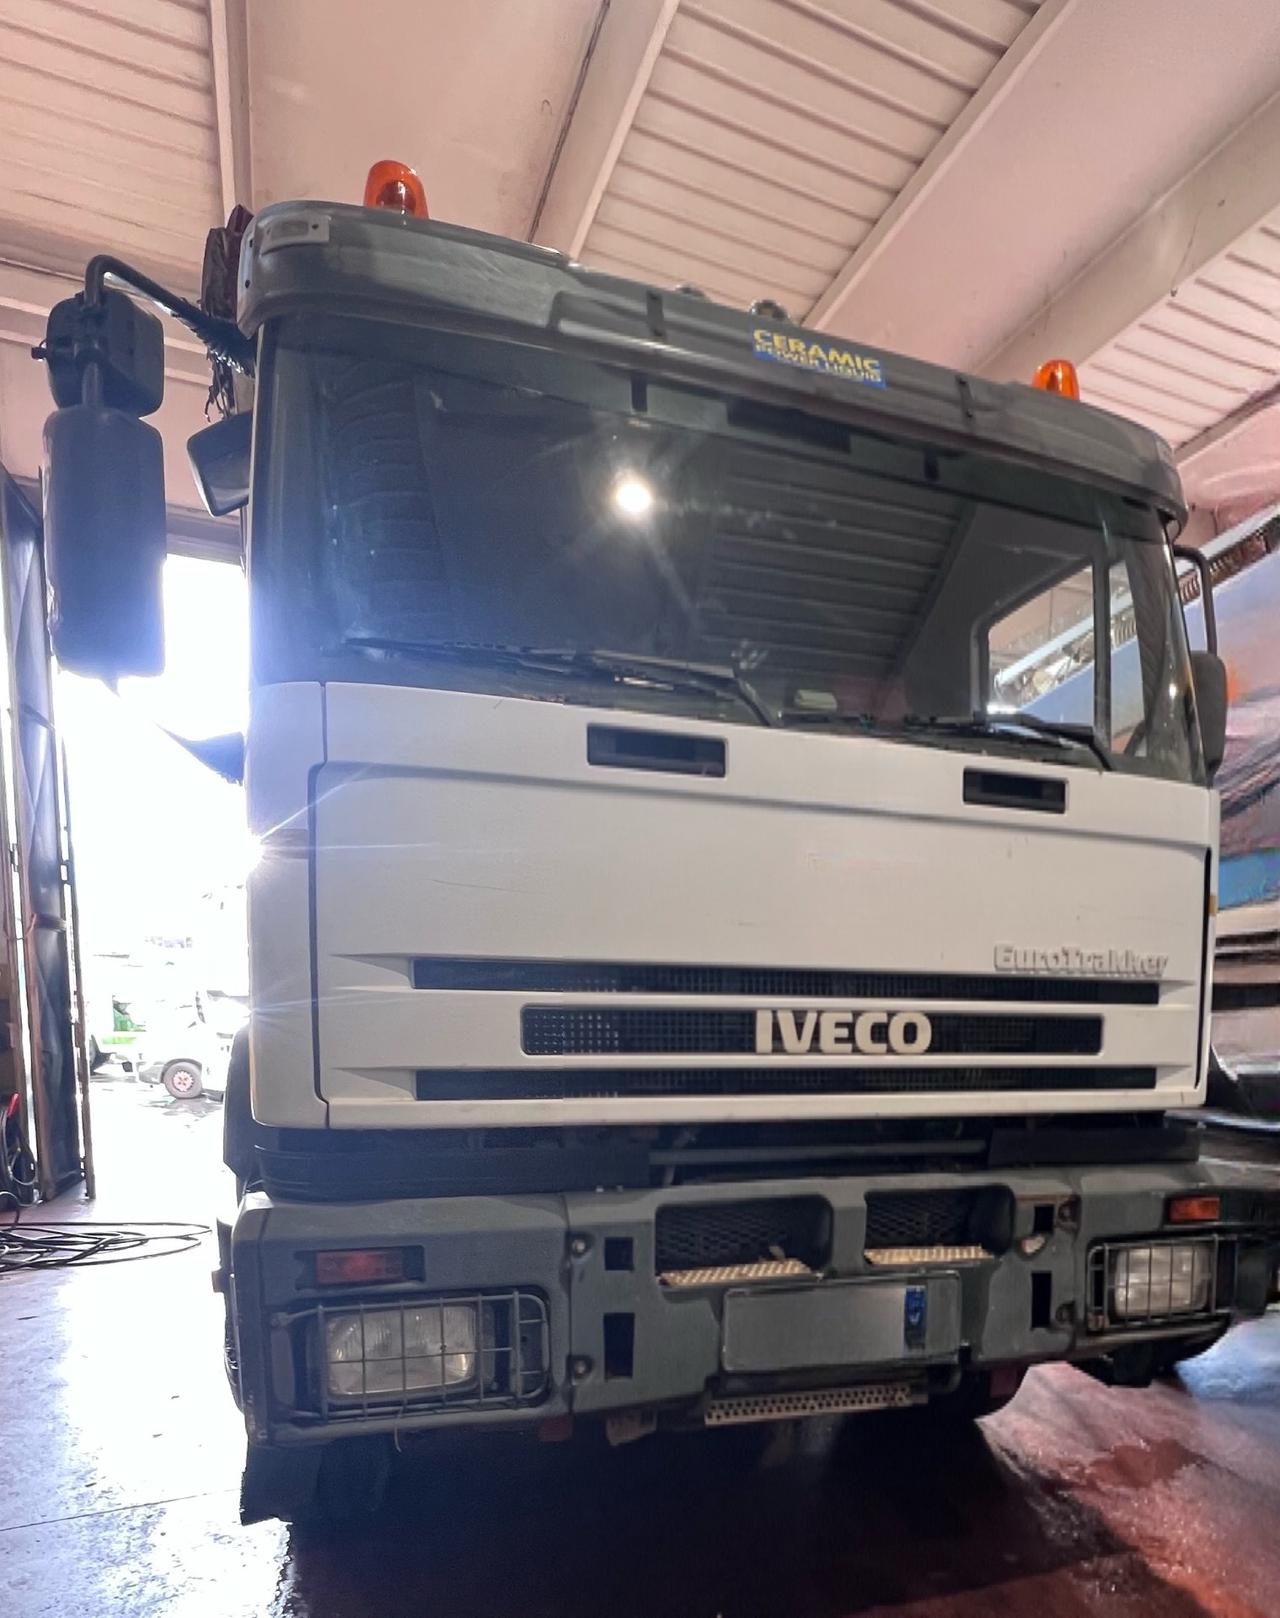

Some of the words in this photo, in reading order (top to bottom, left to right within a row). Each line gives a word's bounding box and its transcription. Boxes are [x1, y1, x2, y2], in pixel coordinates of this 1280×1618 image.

[753, 329, 880, 371] CERAMIC
[993, 944, 1168, 979] EuroTrakker
[756, 1008, 932, 1054] IVECO
